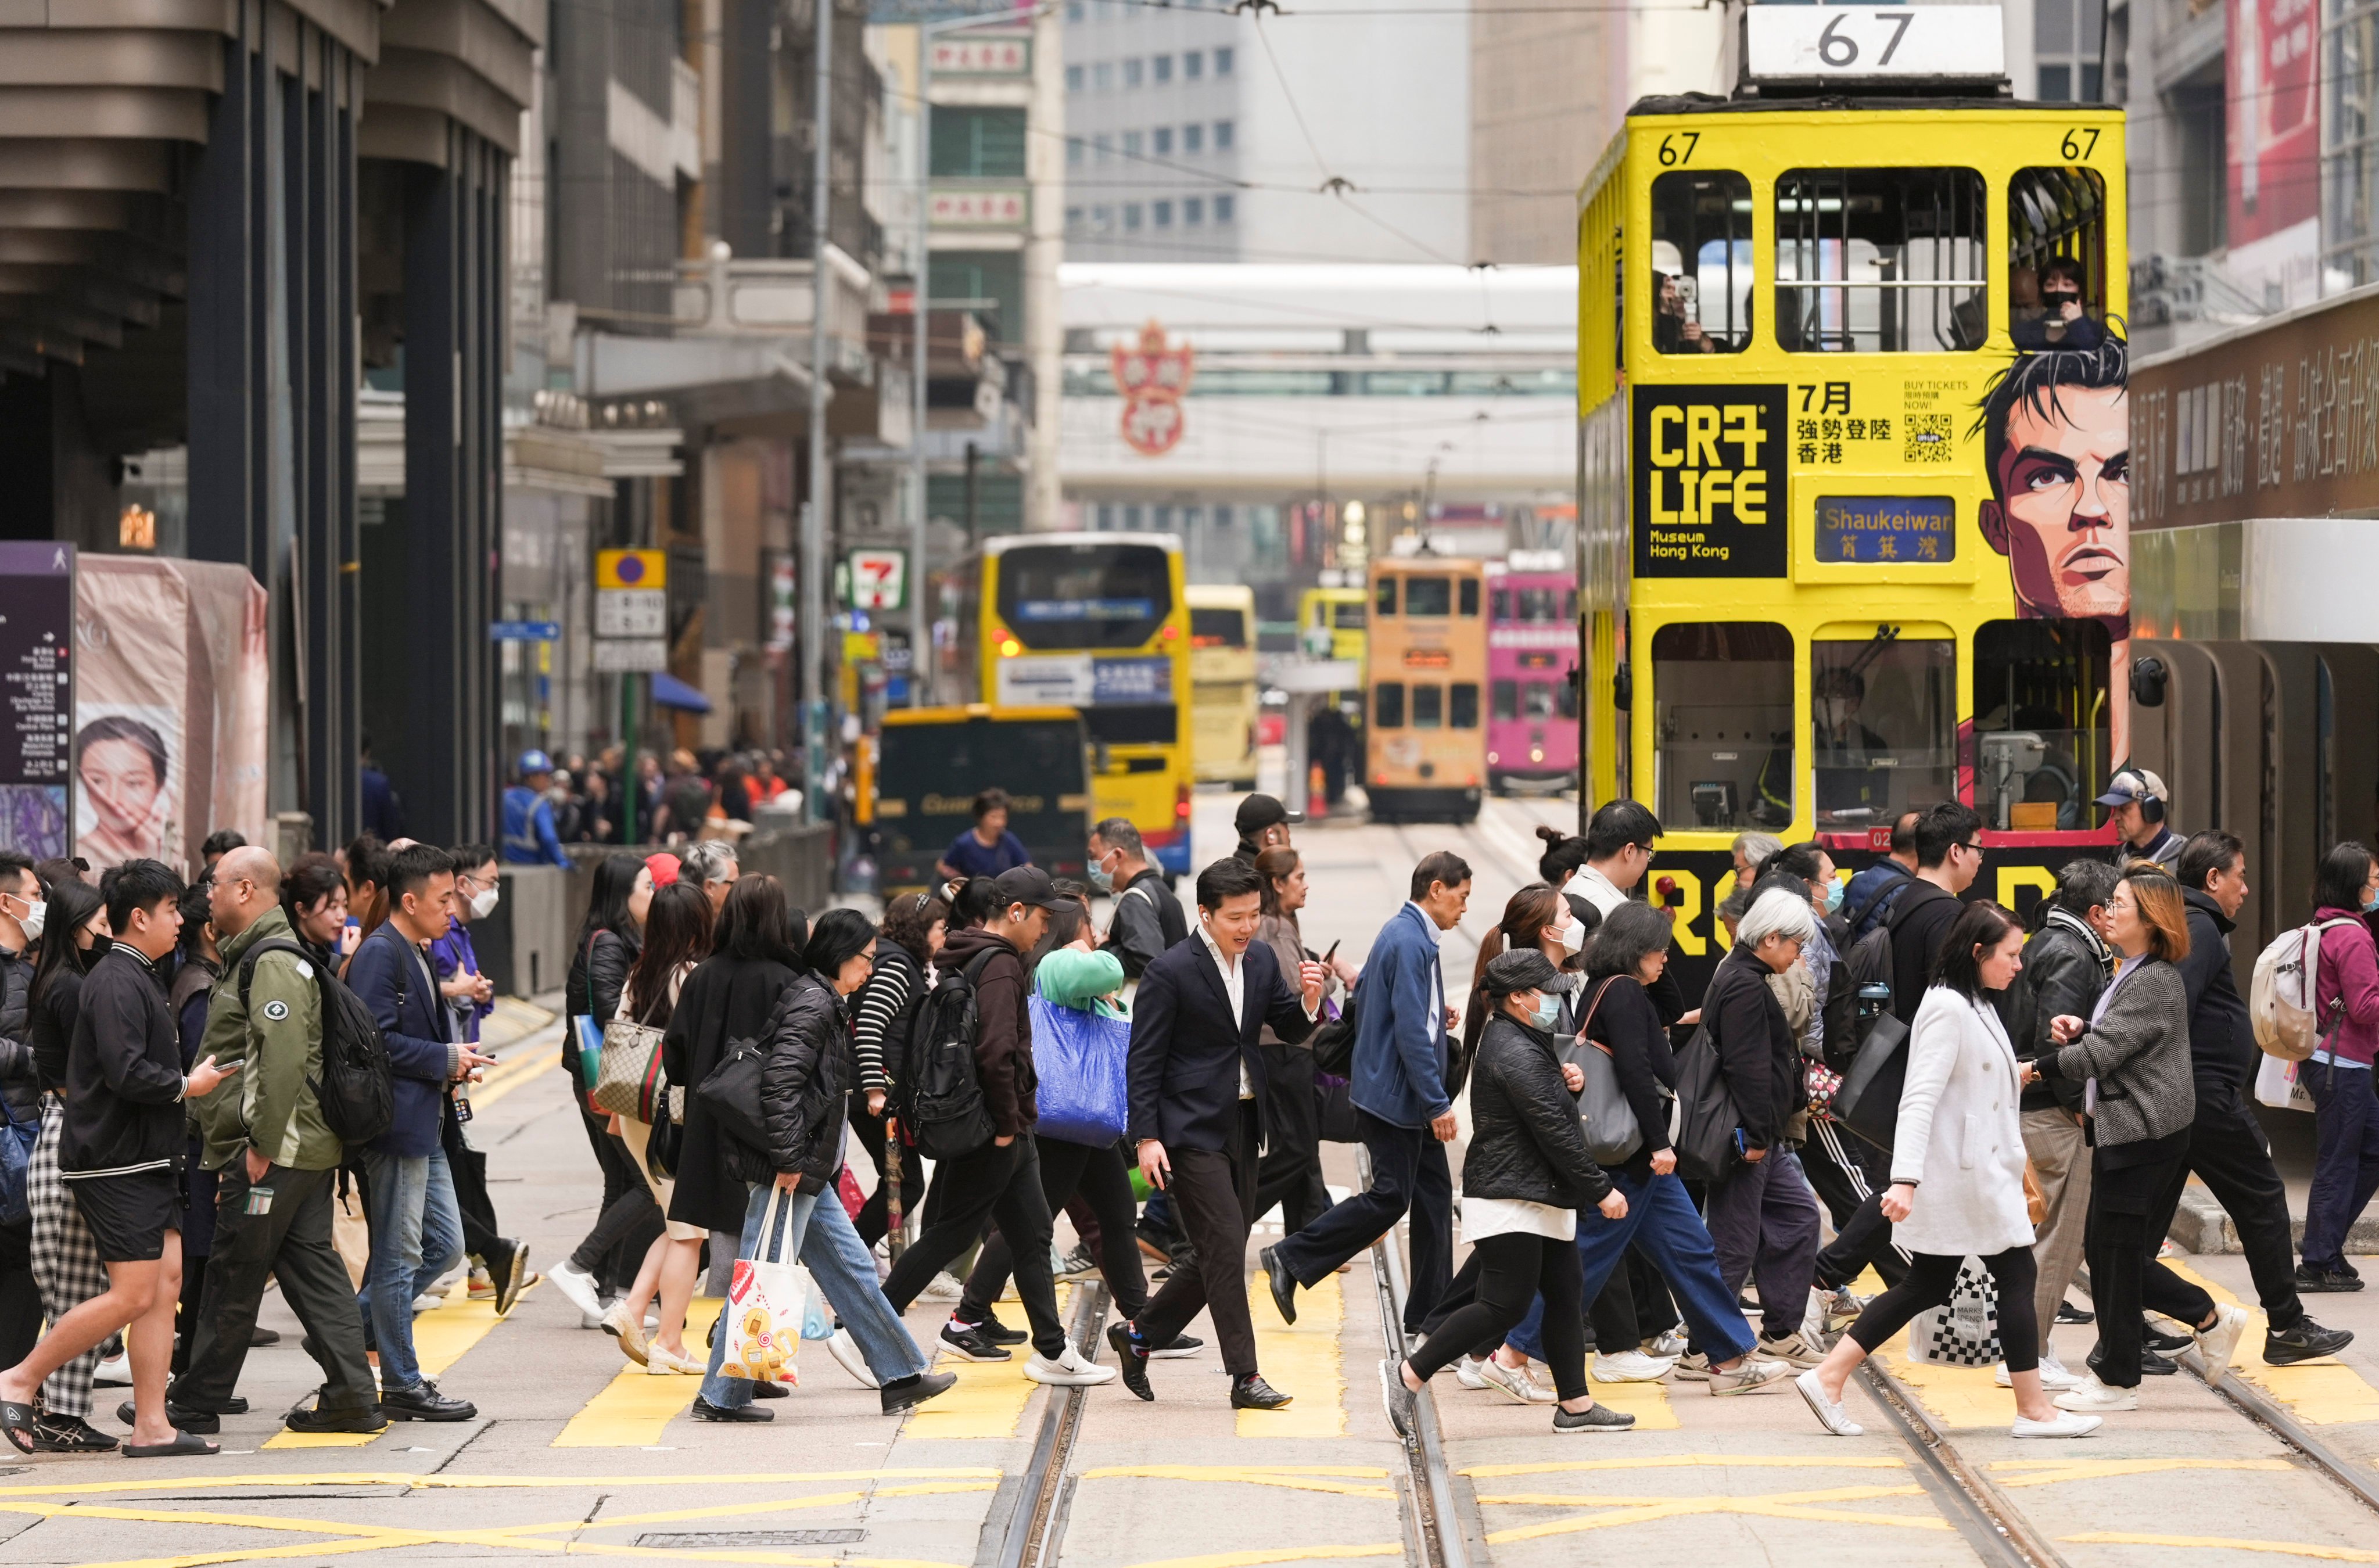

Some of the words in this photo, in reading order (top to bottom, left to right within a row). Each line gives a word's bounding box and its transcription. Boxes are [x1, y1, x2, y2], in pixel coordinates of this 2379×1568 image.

[1819, 13, 1914, 66] 67
[1659, 132, 1700, 166] 67
[2061, 128, 2101, 160] 67
[1904, 381, 1924, 390] BUY
[1927, 381, 1968, 390] TICKETS
[1797, 382, 1850, 415] 7月
[1904, 400, 1932, 410] NOW!
[1797, 418, 1892, 440] 強勢登陸
[1797, 442, 1843, 464] 香港
[1650, 470, 1766, 524] LIFE
[1650, 529, 1705, 543] Museum
[1650, 544, 1687, 561] Hong
[1692, 544, 1729, 561] Kong
[2290, 1086, 2305, 1100] Ms.
